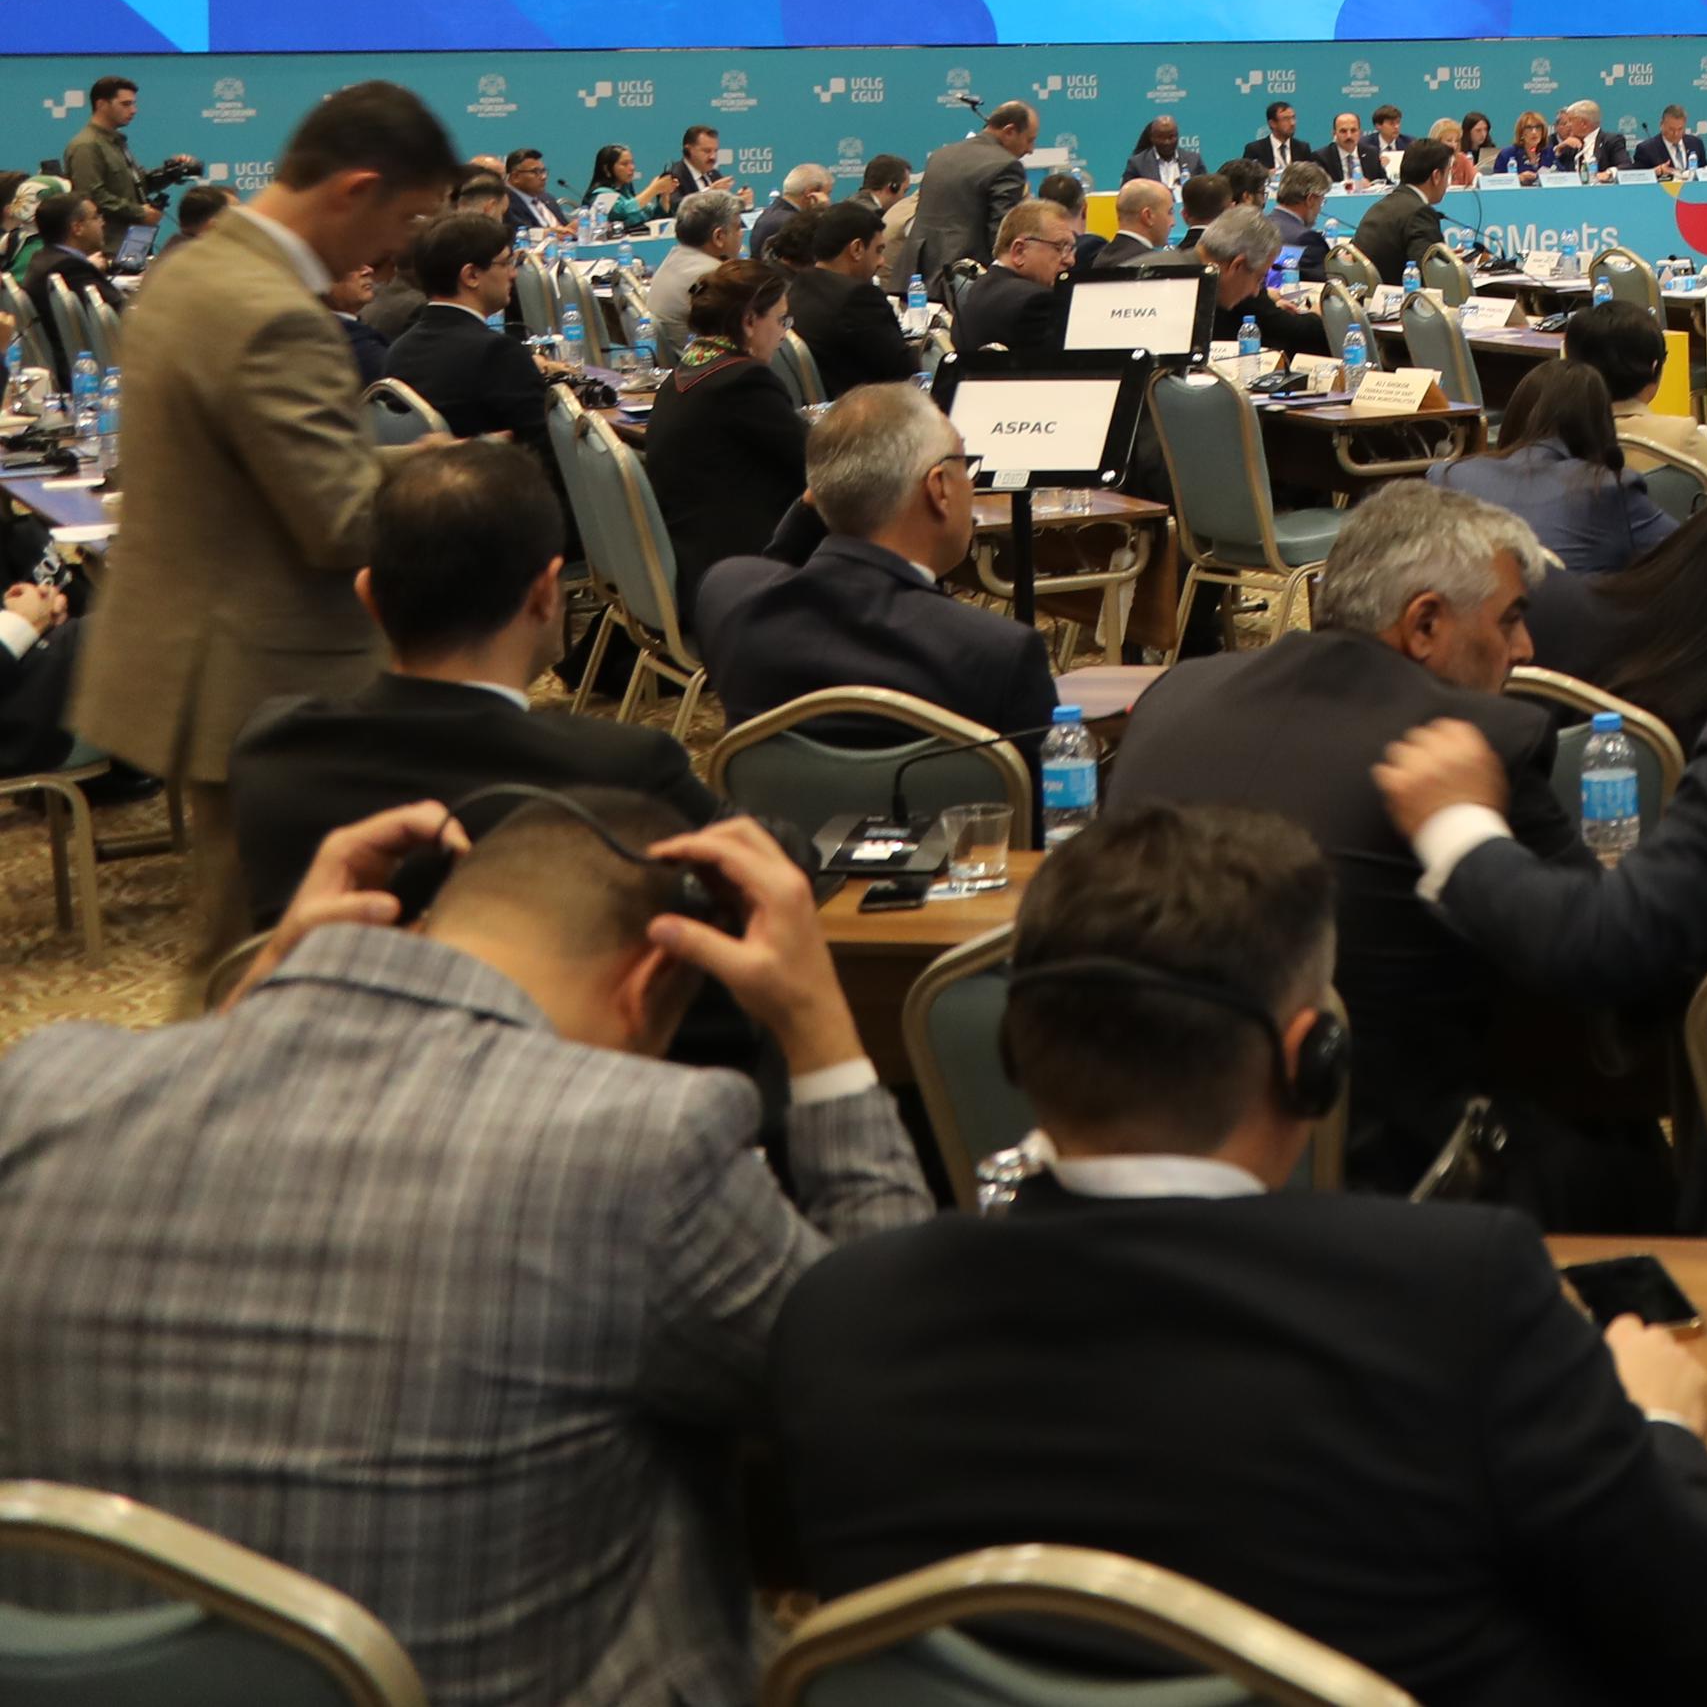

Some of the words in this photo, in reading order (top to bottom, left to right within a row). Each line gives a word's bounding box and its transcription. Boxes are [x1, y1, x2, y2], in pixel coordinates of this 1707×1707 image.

[1267, 69, 1296, 81] UCLG
[1454, 66, 1481, 78] UCLG
[1628, 63, 1653, 75] UCLG
[851, 77, 883, 89] UCLG
[1067, 74, 1097, 87] UCLG
[1454, 78, 1481, 90] CGLU
[1628, 74, 1653, 86] CGLU
[618, 80, 654, 93] UCLG
[1267, 82, 1296, 93] CGLU
[851, 90, 883, 103] CGLU
[1067, 88, 1097, 100] CGLU
[618, 94, 654, 107] CGLU
[1178, 135, 1200, 148] CLG
[739, 147, 772, 160] UCLG
[235, 161, 275, 175] UCLG
[739, 161, 772, 173] CGLU
[1110, 306, 1159, 319] MEWA
[991, 420, 1057, 436] ASPAC
